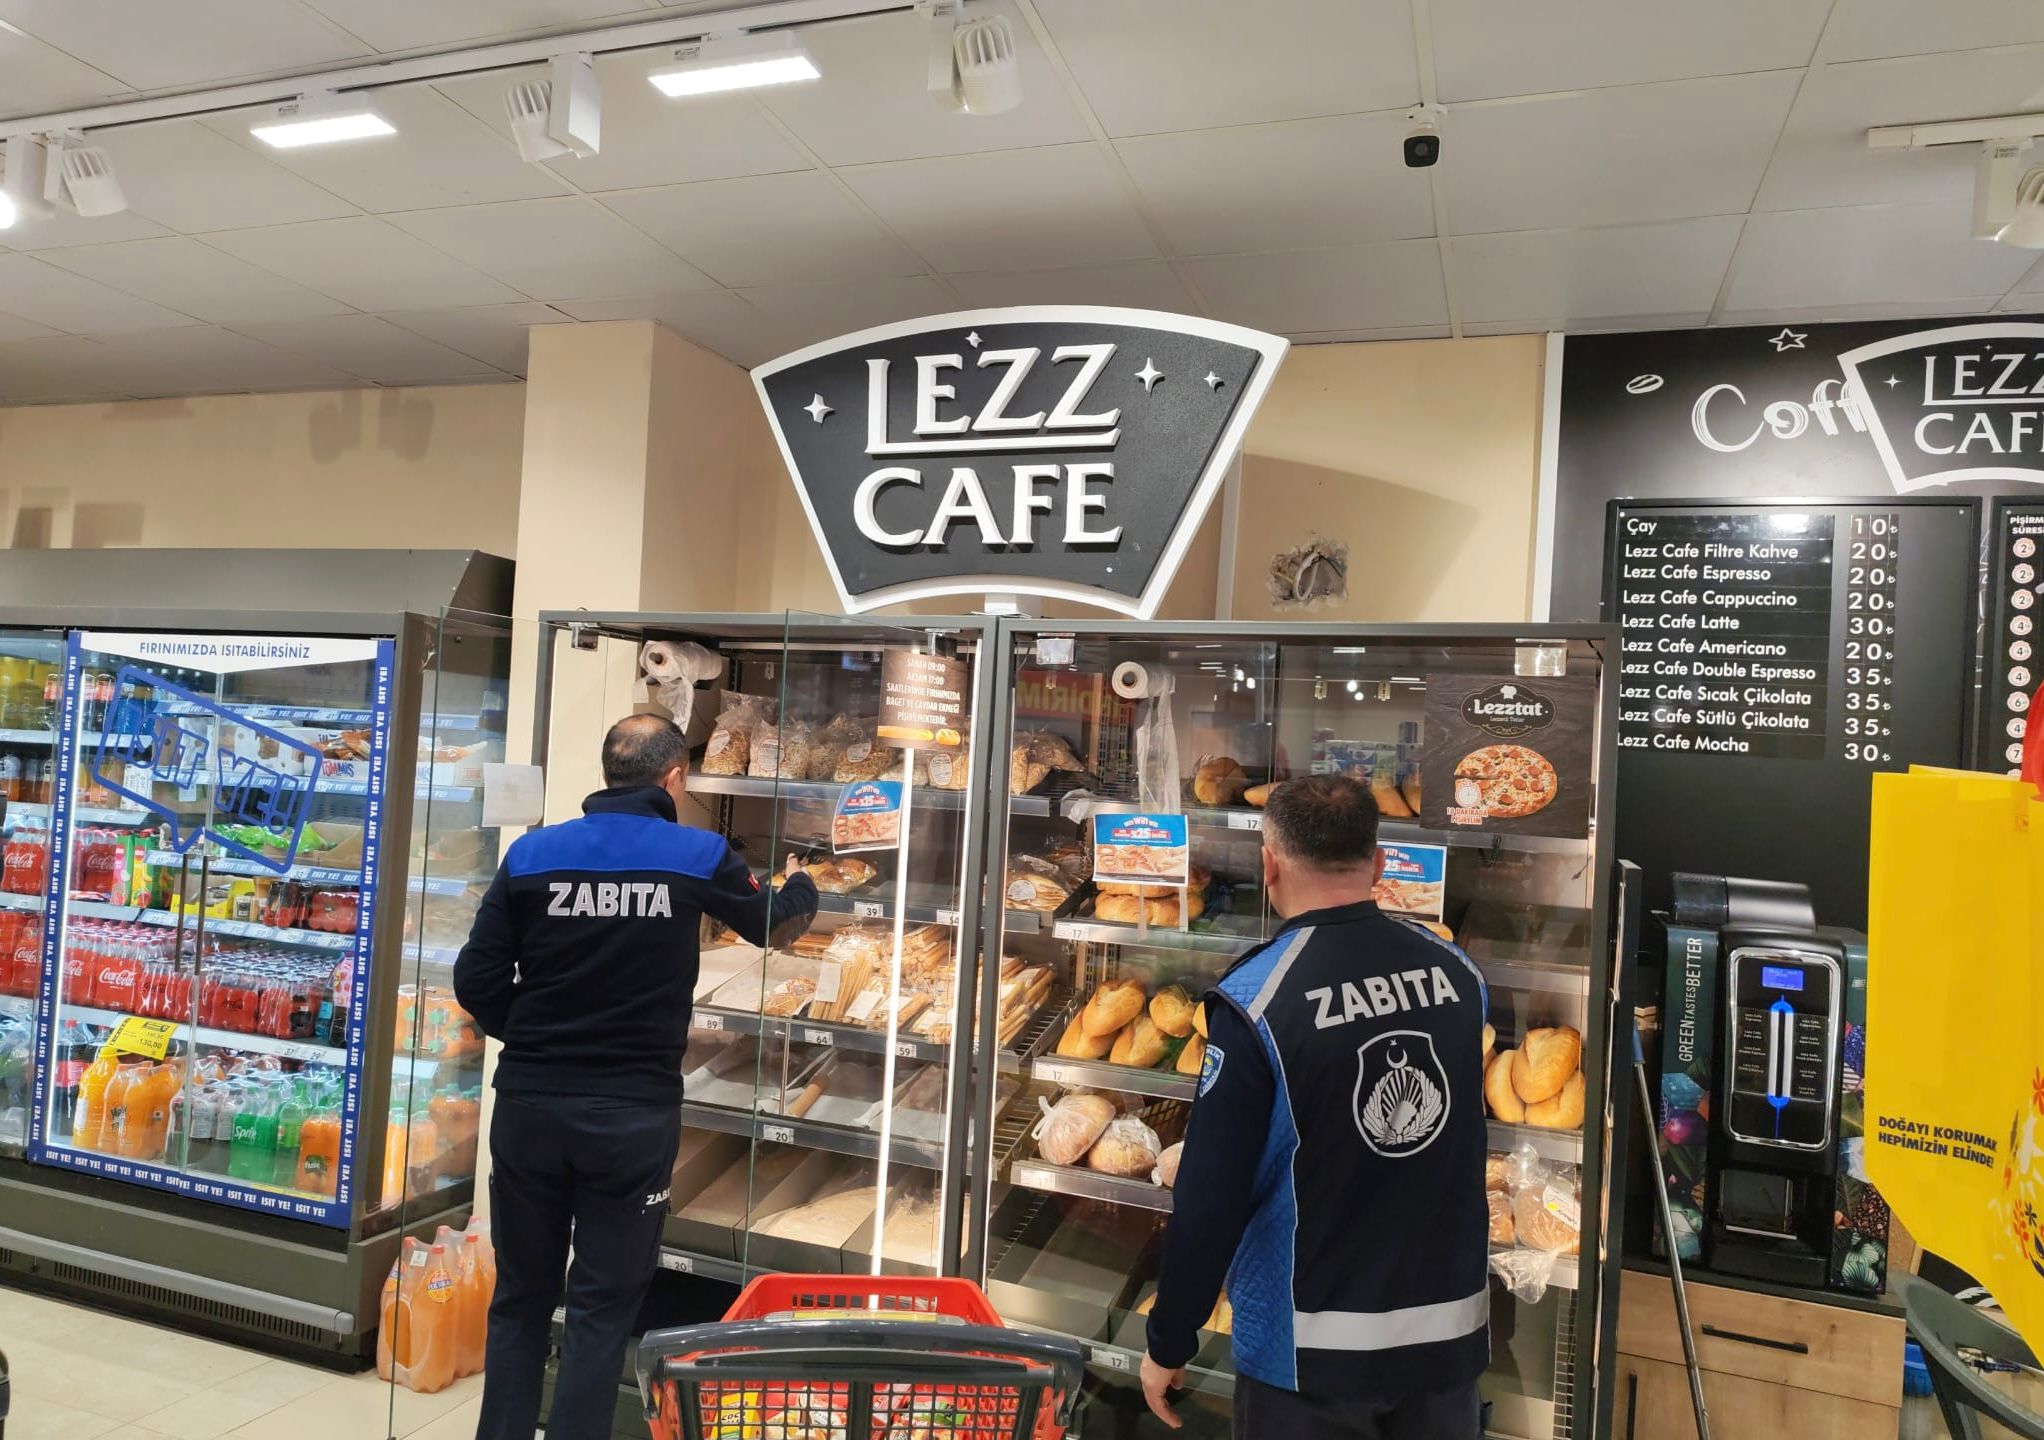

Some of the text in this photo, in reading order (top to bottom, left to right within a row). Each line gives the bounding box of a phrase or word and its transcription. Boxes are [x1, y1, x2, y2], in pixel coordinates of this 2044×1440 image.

[865, 343, 1121, 454] LEZZ
[1914, 411, 2044, 455] CAF
[853, 462, 1123, 546] CAFE
[1626, 518, 1658, 535] Çay
[1625, 544, 1799, 559] Lezz Cafe Filtre Kahve
[1624, 565, 1771, 582] Lezz Cafe Espresso
[1623, 590, 1797, 609] Lezz Cafe Cappuccino
[1622, 614, 1740, 630] Lezz Cafe Latte
[139, 642, 310, 658] FIRINIMIZDA ISITABİLİRSİNİZ
[1622, 638, 1786, 656] Lezz Cafe Americano
[1620, 661, 1816, 681] Lezz Cafe Double Espresso
[378, 667, 388, 704] ISIT YE!
[1620, 684, 1812, 706] Lezz Cafe Sıcak Çikolata
[1474, 699, 1542, 716] Lezztat
[64, 714, 72, 731] ISIT
[1619, 708, 1809, 730] Lezz Cafe Sütlü Çikolata
[375, 711, 385, 749] ISIT YE!
[1617, 733, 1749, 752] Lezz Cafe Mocha
[368, 801, 378, 839] ISIT YE!
[1247, 820, 1258, 829] 17
[365, 846, 374, 884] ISIT YE!
[548, 883, 672, 918] ZABITA
[866, 907, 878, 916] 39
[358, 937, 367, 975] ISIT YE!
[1304, 965, 1460, 1030] ZABITA
[707, 1020, 718, 1028] 89
[351, 1028, 360, 1066] ISIT YE!
[816, 1035, 828, 1044] 64
[899, 1047, 911, 1056] 59
[347, 1093, 355, 1111] ISIT
[32, 1123, 40, 1140] ISIT
[775, 1132, 788, 1142] 20
[1879, 1115, 1997, 1152] DOĞAYI KORUMAK
[46, 1151, 71, 1162] ISIT YE!
[1878, 1131, 1994, 1169] HEPİMİZİN ELİNDE!
[75, 1157, 100, 1169] ISIT YE!
[105, 1163, 131, 1175] ISIT YE!
[135, 1170, 161, 1182] ISIT YE!
[166, 1176, 190, 1190] ISIT YE!
[340, 1164, 350, 1203] ISIT YE!
[195, 1183, 223, 1196] ISIT YE!
[228, 1190, 256, 1203] ISIT YE!
[261, 1197, 290, 1210] ISIT YE!
[296, 1204, 325, 1217] ISIT YE!
[675, 1262, 687, 1271] 20
[1111, 1357, 1122, 1368] 17
